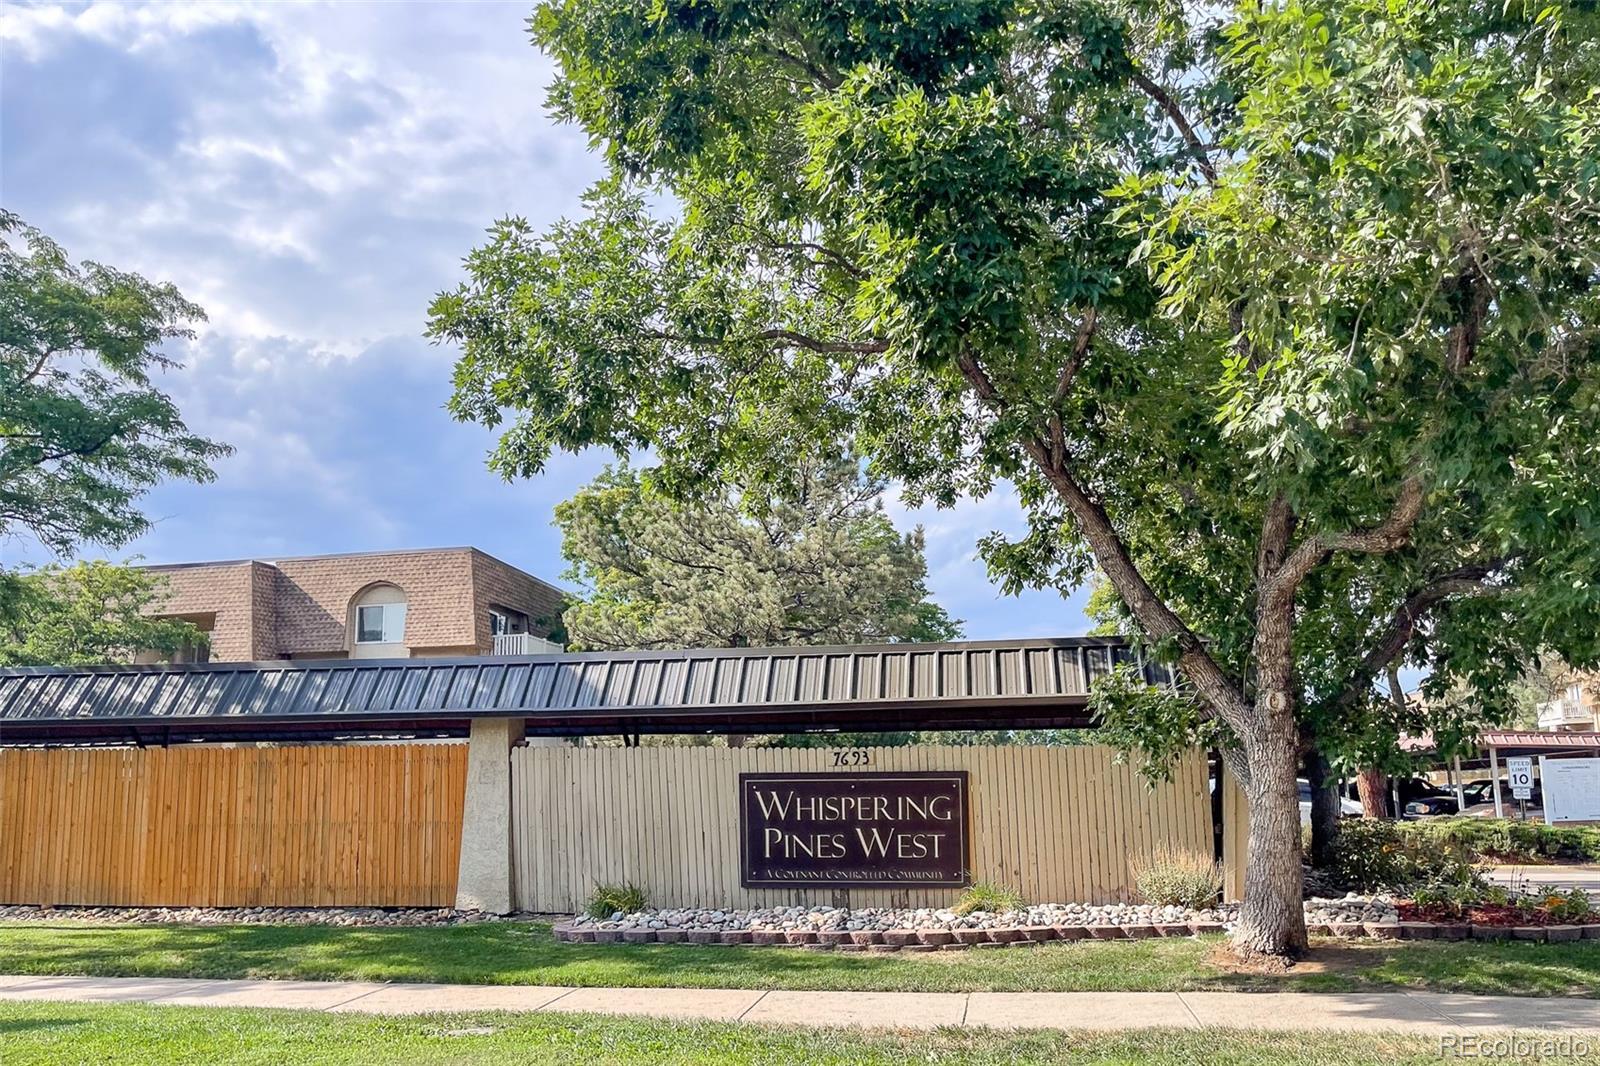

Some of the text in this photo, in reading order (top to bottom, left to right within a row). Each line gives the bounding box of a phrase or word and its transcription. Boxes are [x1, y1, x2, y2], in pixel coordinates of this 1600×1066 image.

[833, 751, 870, 766] 7693
[1512, 774, 1529, 785] 10
[755, 791, 952, 821] WHISPERING
[764, 828, 946, 859] PINES WEST
[767, 869, 774, 879] A
